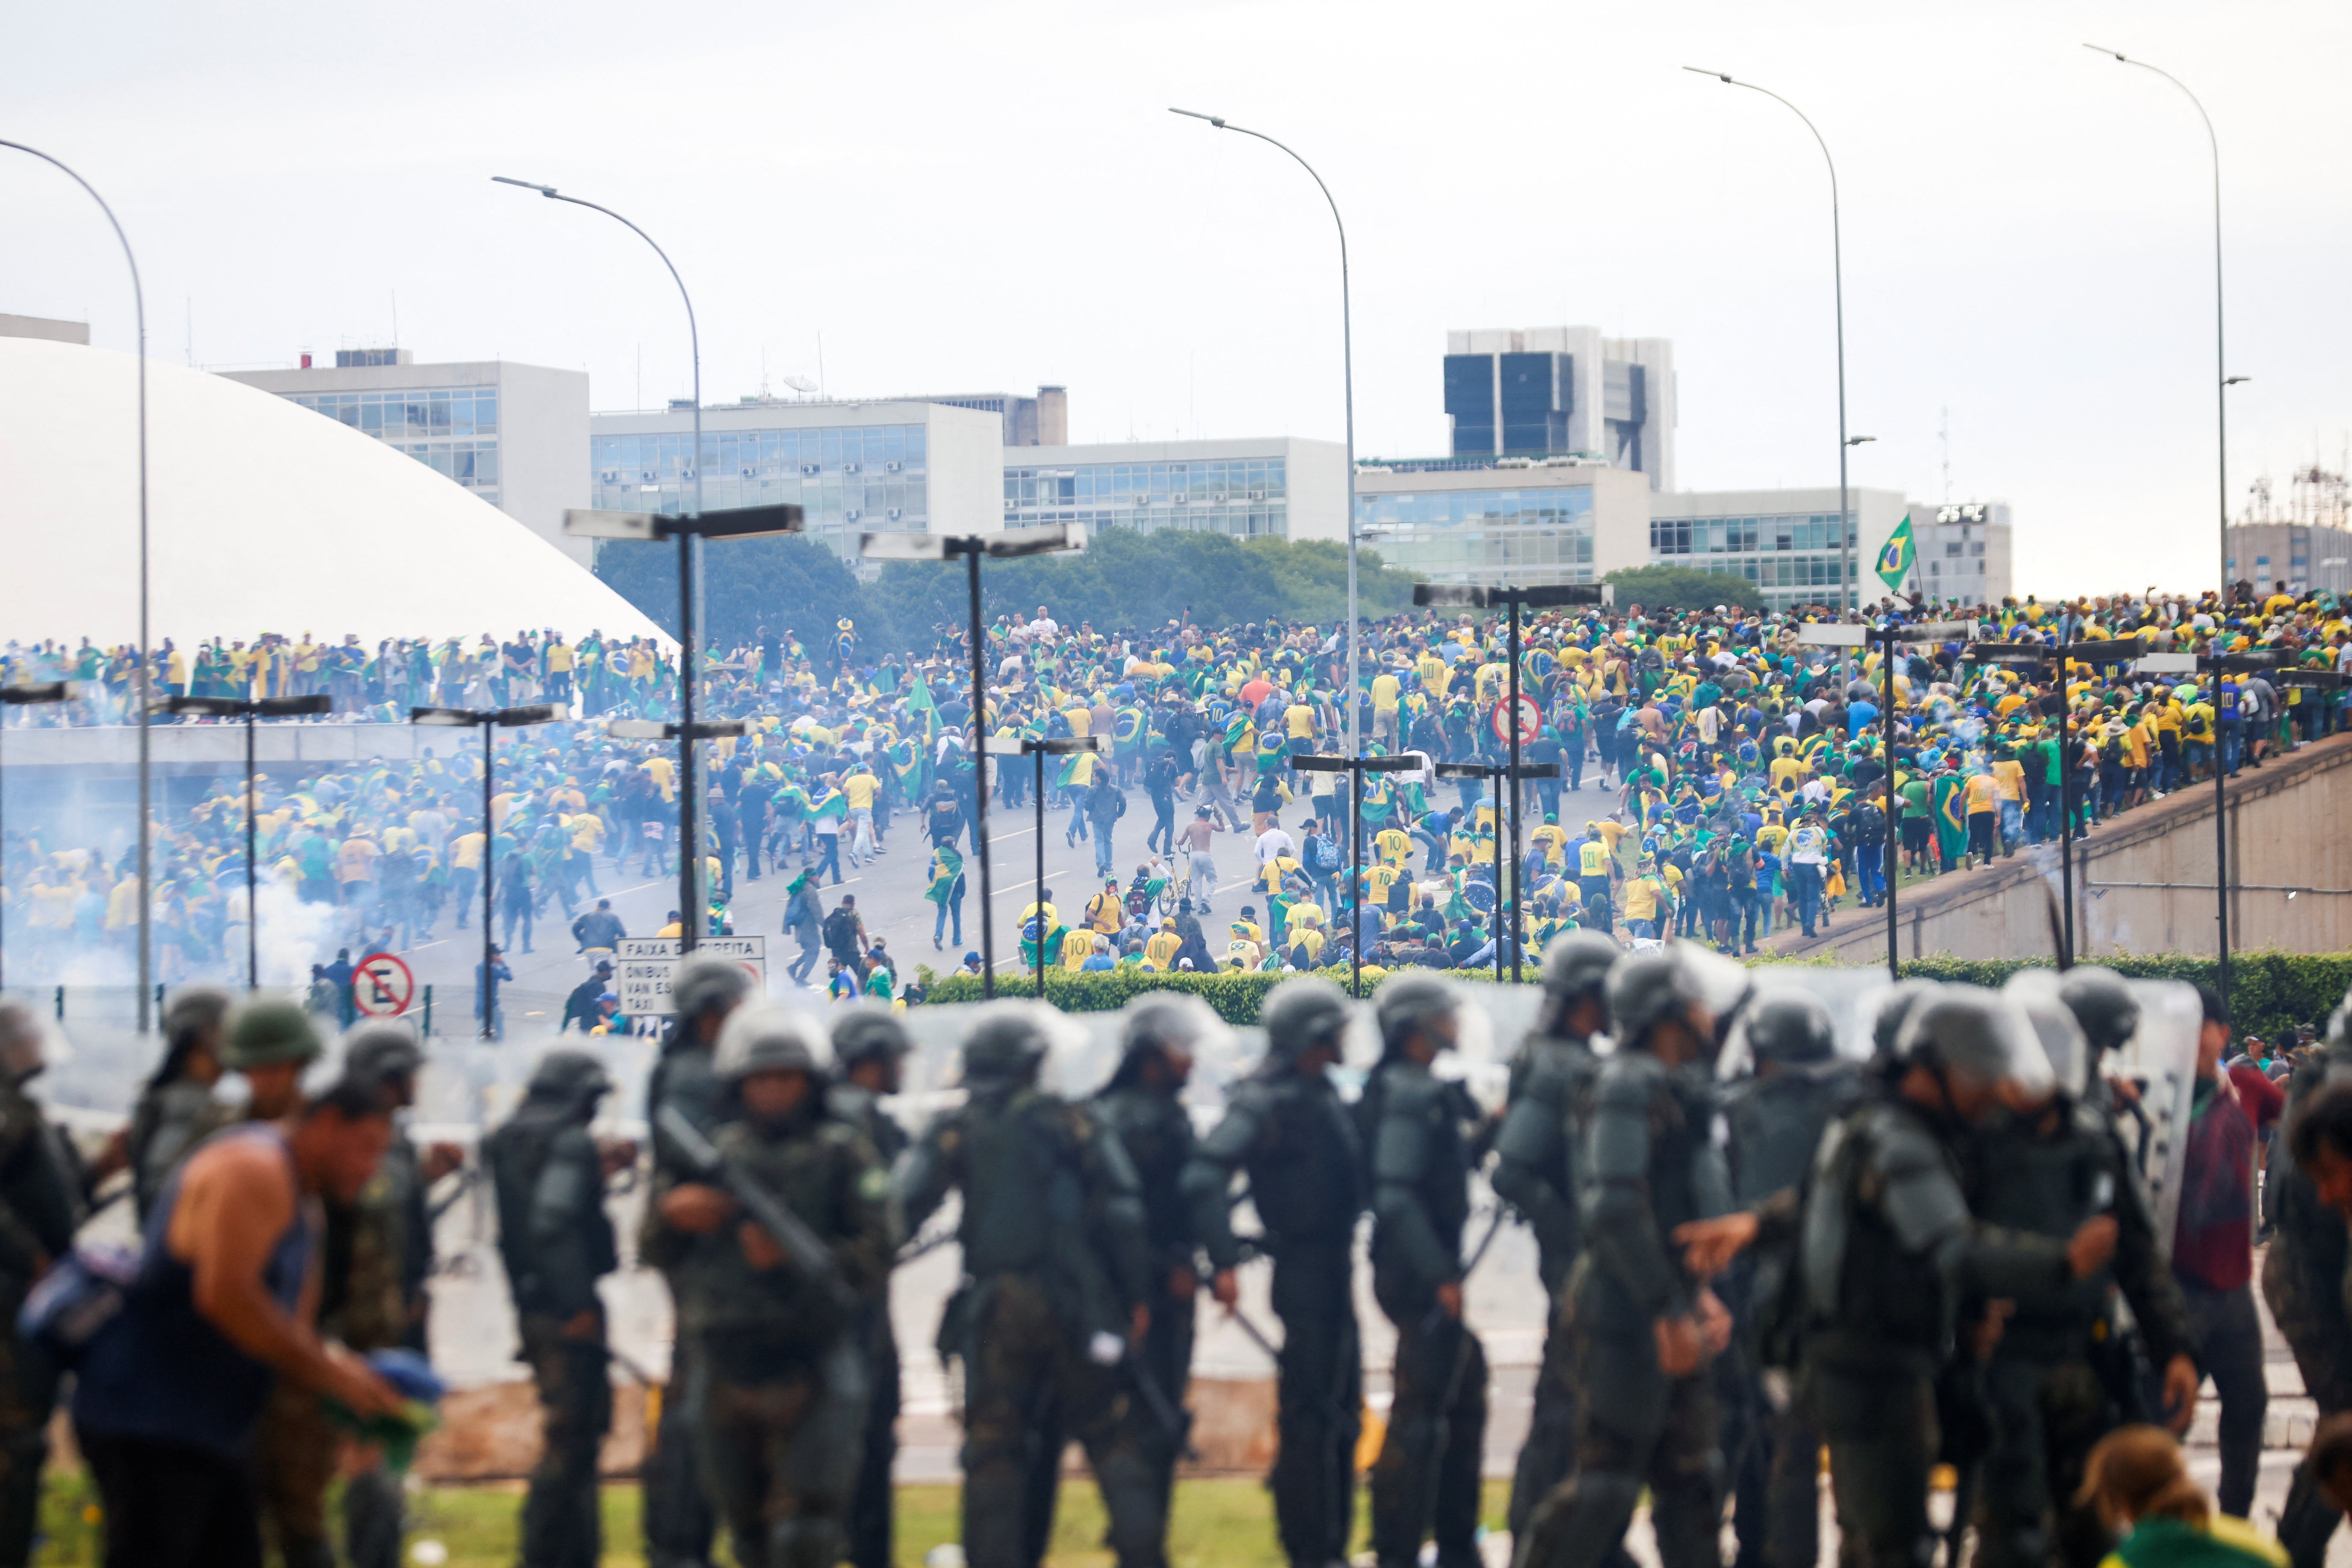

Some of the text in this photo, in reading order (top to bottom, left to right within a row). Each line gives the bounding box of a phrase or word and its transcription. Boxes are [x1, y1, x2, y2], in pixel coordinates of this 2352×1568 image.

[1666, 640, 1680, 652] 10
[1423, 663, 1434, 679] 10
[2106, 664, 2119, 678] 10
[2222, 691, 2234, 707] 10
[1212, 707, 1224, 723] 10
[1972, 788, 1988, 802] 10
[1388, 836, 1401, 851] 10
[1583, 851, 1596, 868] 10
[1379, 872, 1391, 886] 10
[626, 943, 668, 956] FAIXA
[1070, 937, 1085, 955] 10
[1155, 940, 1167, 959] 10
[373, 969, 395, 1004] E
[626, 982, 650, 994] VAN
